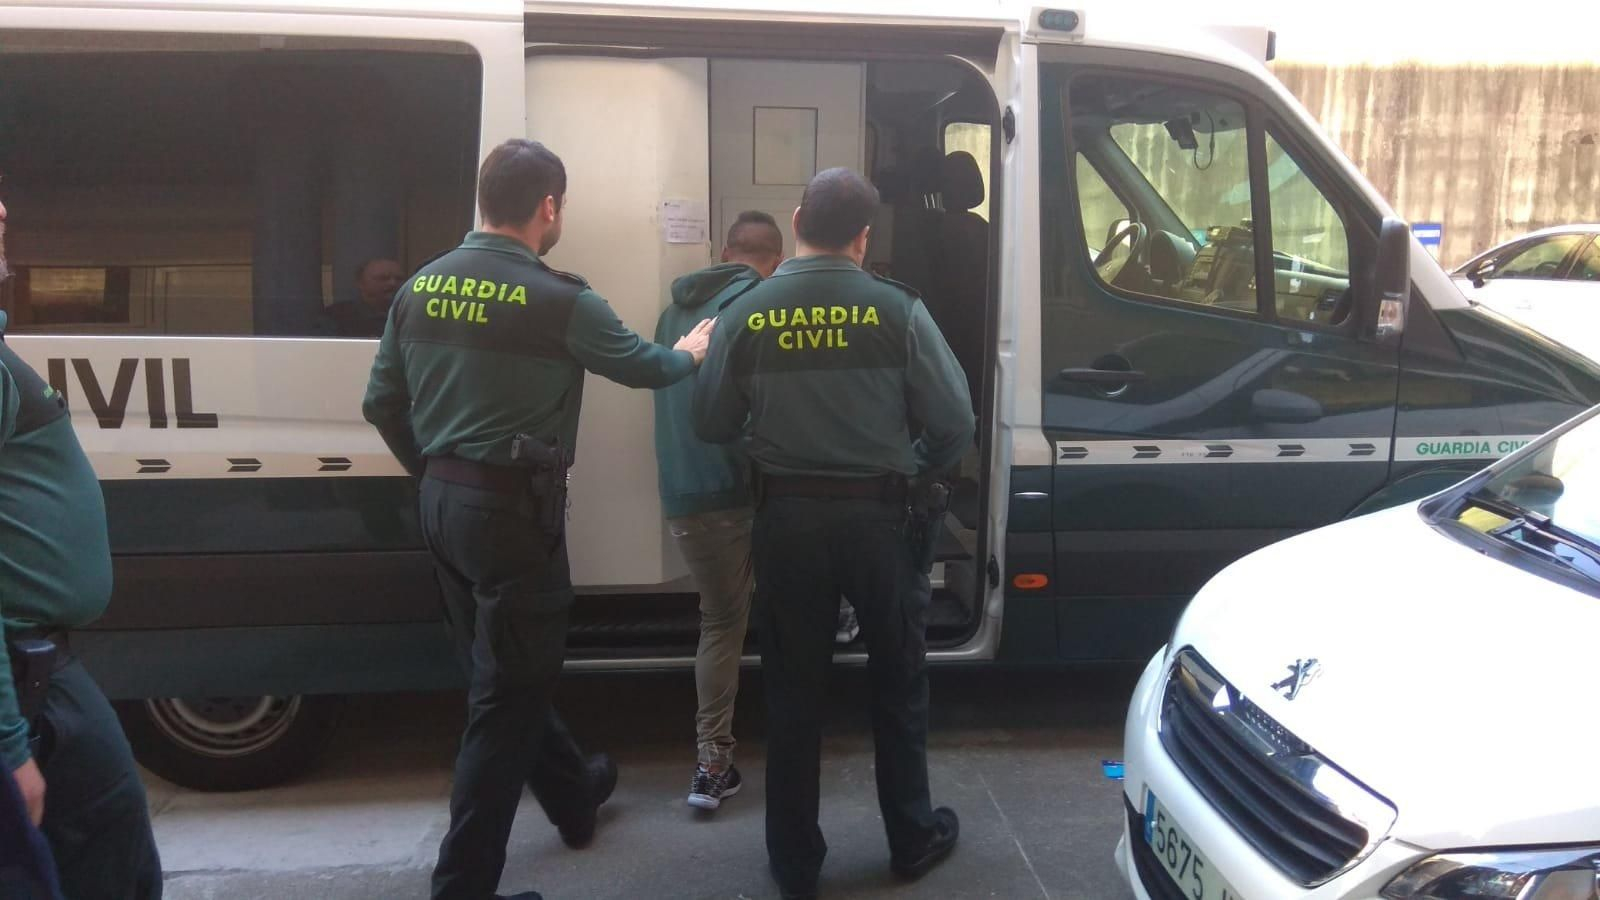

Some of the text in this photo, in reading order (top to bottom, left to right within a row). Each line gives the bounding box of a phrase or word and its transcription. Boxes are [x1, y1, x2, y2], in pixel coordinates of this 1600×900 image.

[413, 274, 527, 305] GUARDIA
[426, 297, 488, 323] CIVIL
[747, 305, 880, 331] GUARDIA
[778, 328, 849, 349] CIVIL
[47, 358, 219, 429] IVIL
[1416, 440, 1531, 455] GUARDIA CIV
[1156, 809, 1204, 900] 5675
